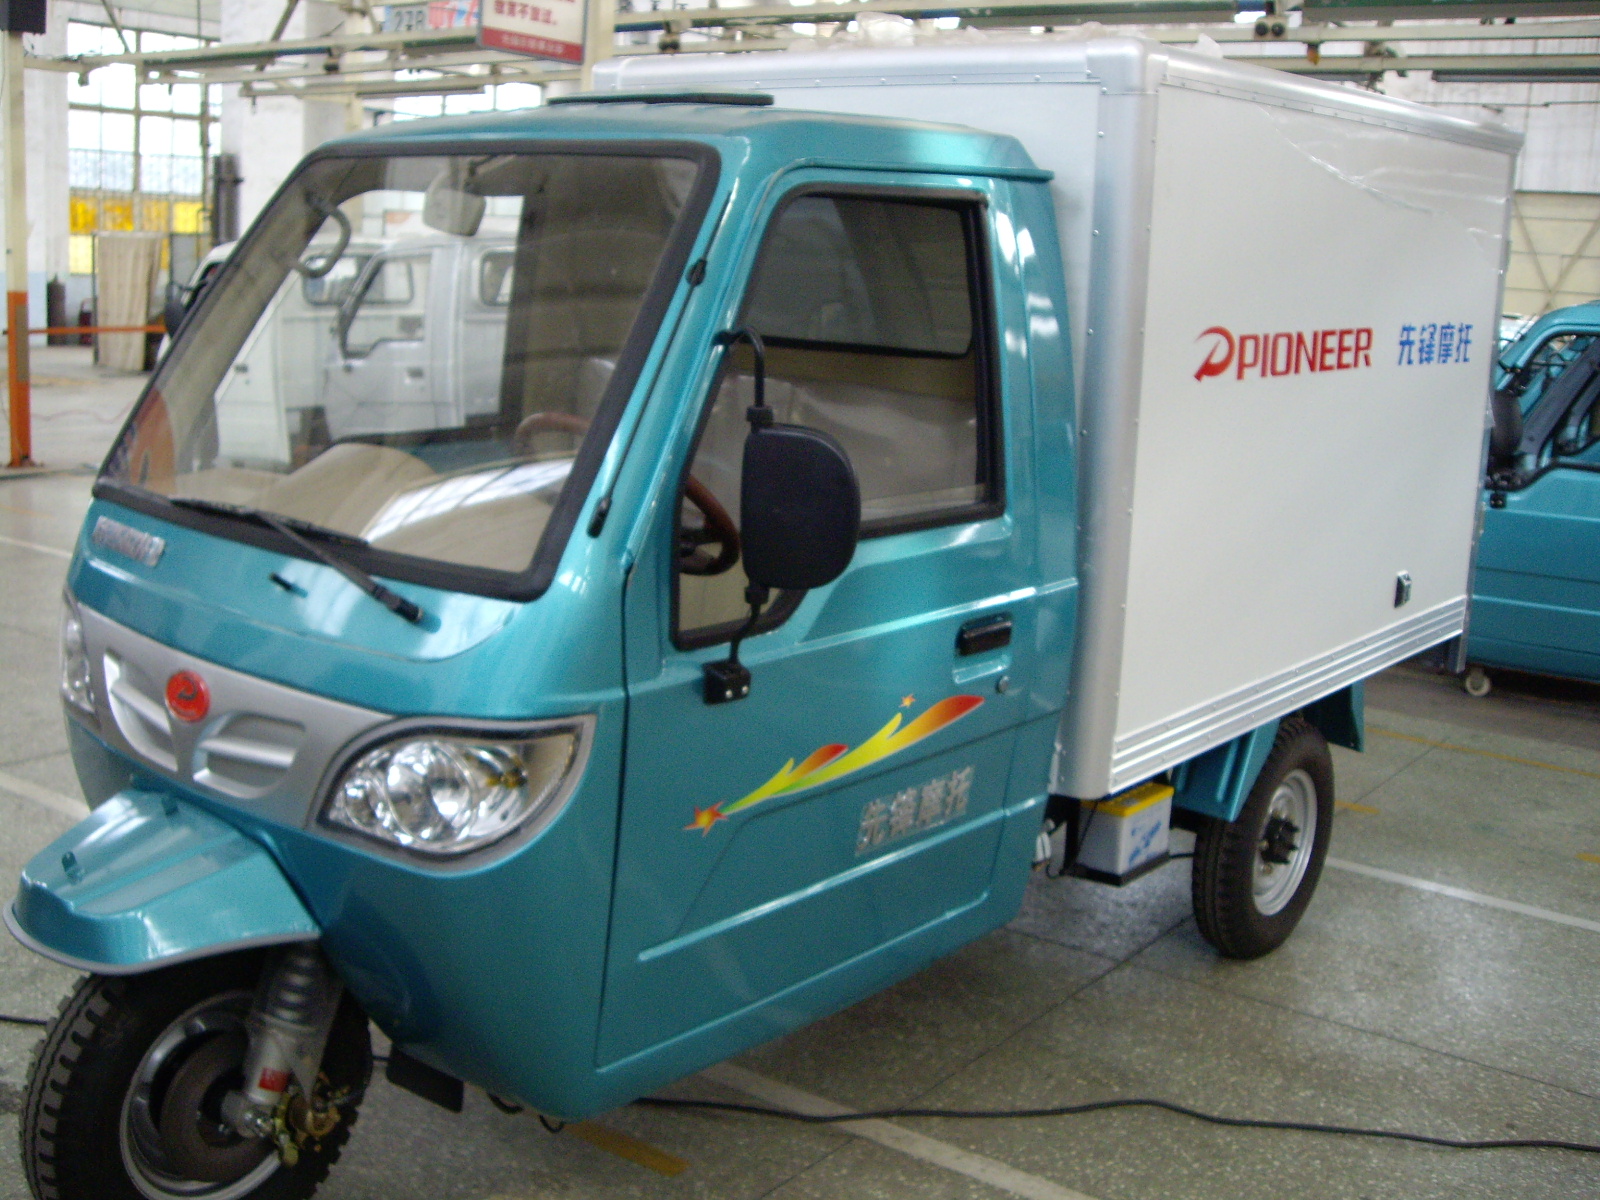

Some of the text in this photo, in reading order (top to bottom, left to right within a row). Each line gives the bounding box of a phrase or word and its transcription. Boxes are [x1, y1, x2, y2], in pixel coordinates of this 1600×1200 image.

[1236, 327, 1374, 381] PIONEER
[1398, 322, 1474, 365] 先锋摩托
